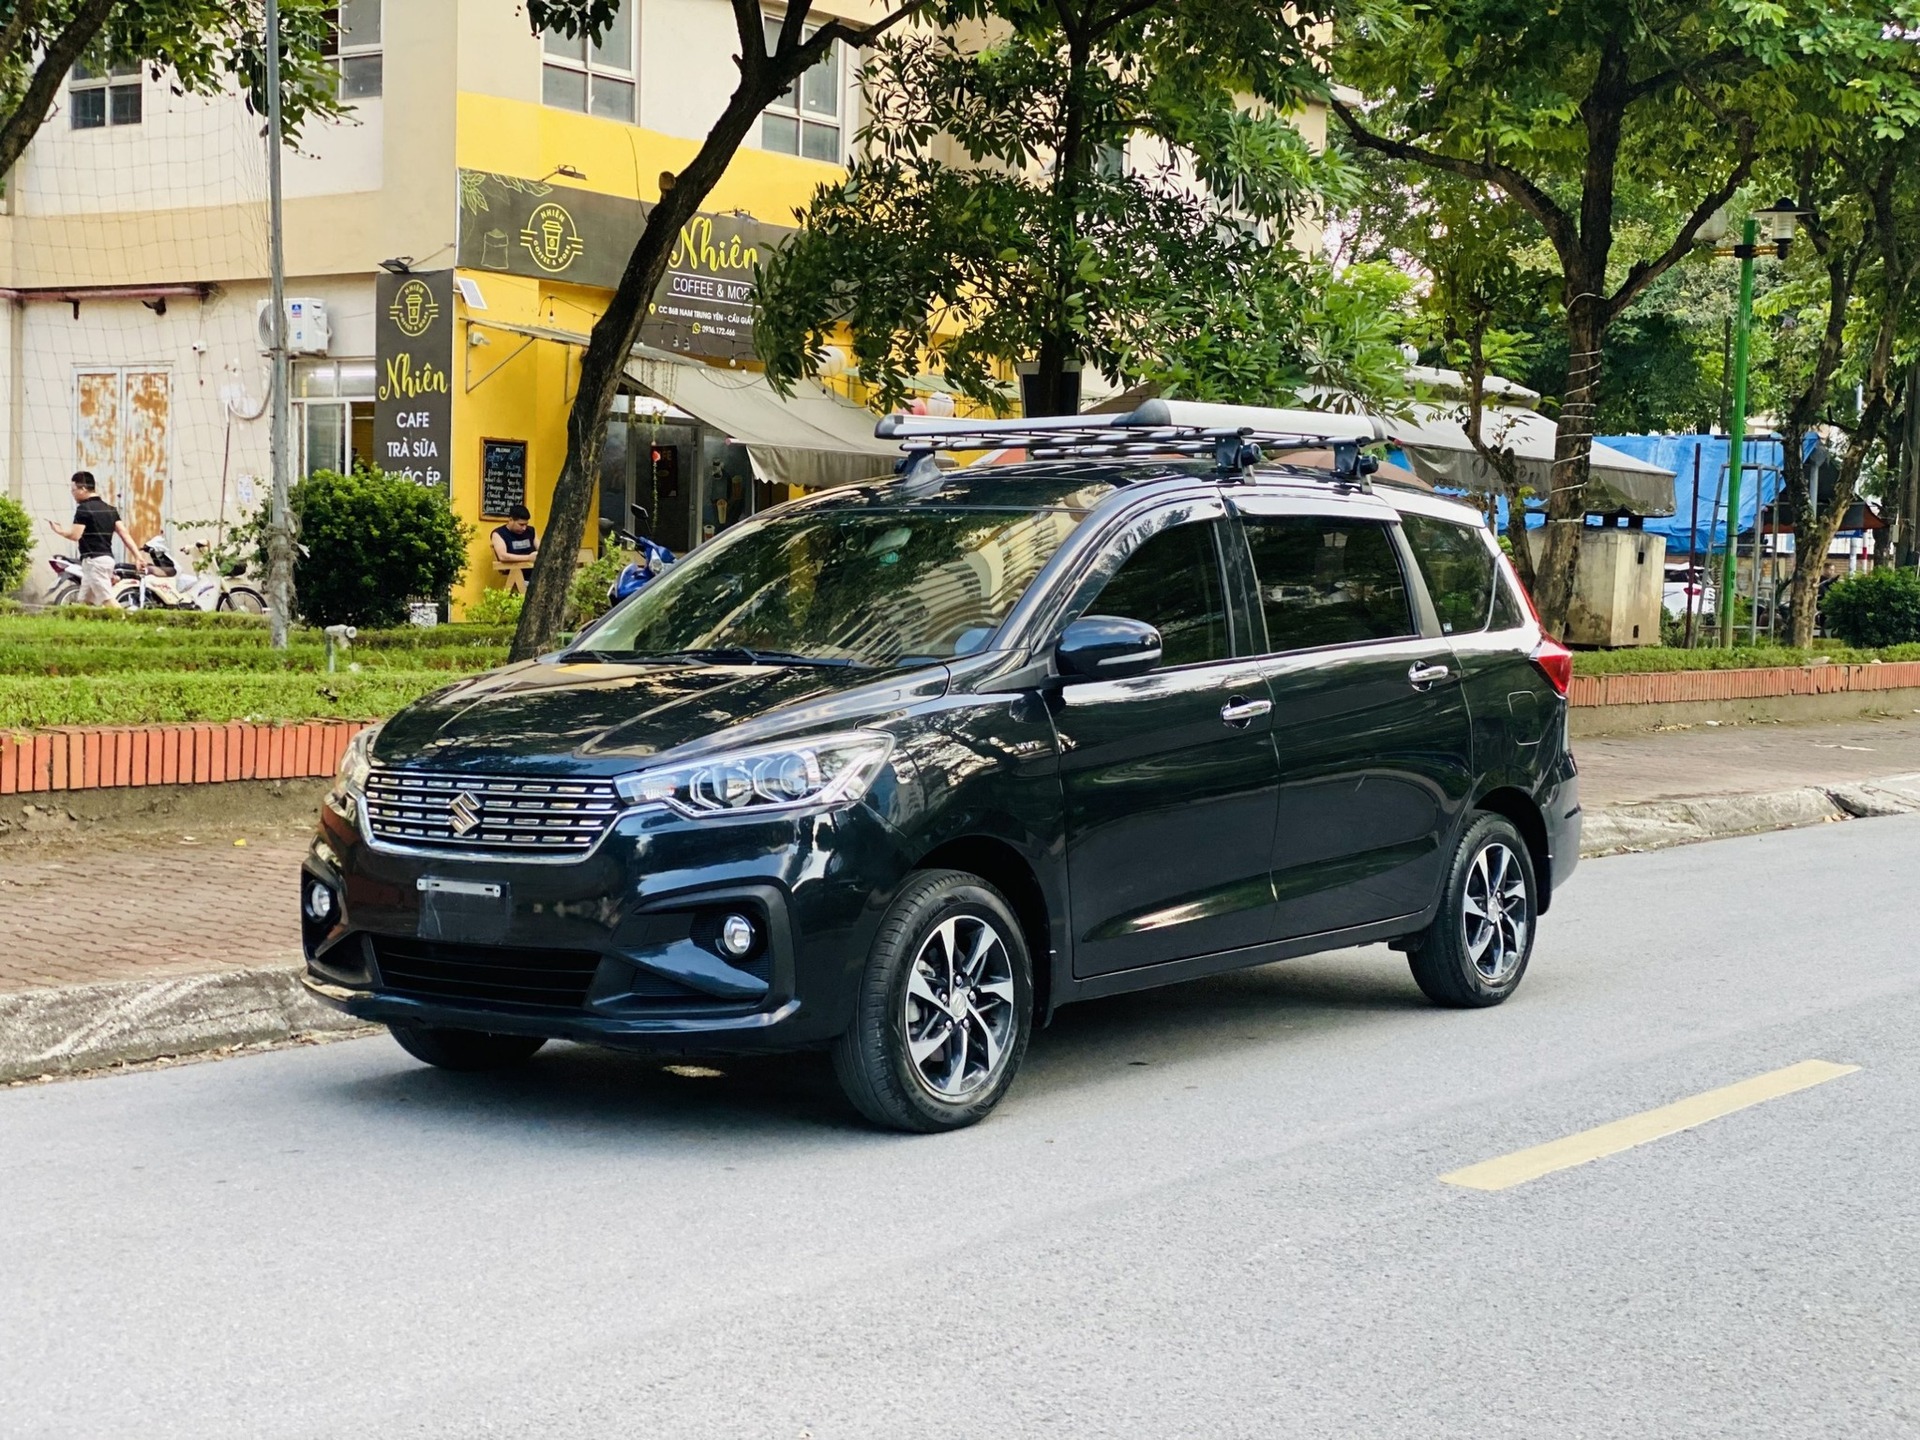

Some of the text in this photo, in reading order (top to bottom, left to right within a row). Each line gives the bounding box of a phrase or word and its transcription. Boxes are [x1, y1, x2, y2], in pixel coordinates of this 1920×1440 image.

[540, 208, 565, 222] NHIÊN
[668, 216, 763, 272] Nhiên
[672, 277, 758, 302] COFFEE & MOR
[658, 305, 668, 314] CC
[679, 308, 693, 318] NAM
[694, 310, 712, 321] TRUNG
[712, 311, 724, 322] YÊN
[378, 352, 448, 401] Nhiên
[396, 412, 430, 428] CAFE
[386, 436, 438, 457] TRÀ SỮA
[425, 466, 441, 487] ÉP
